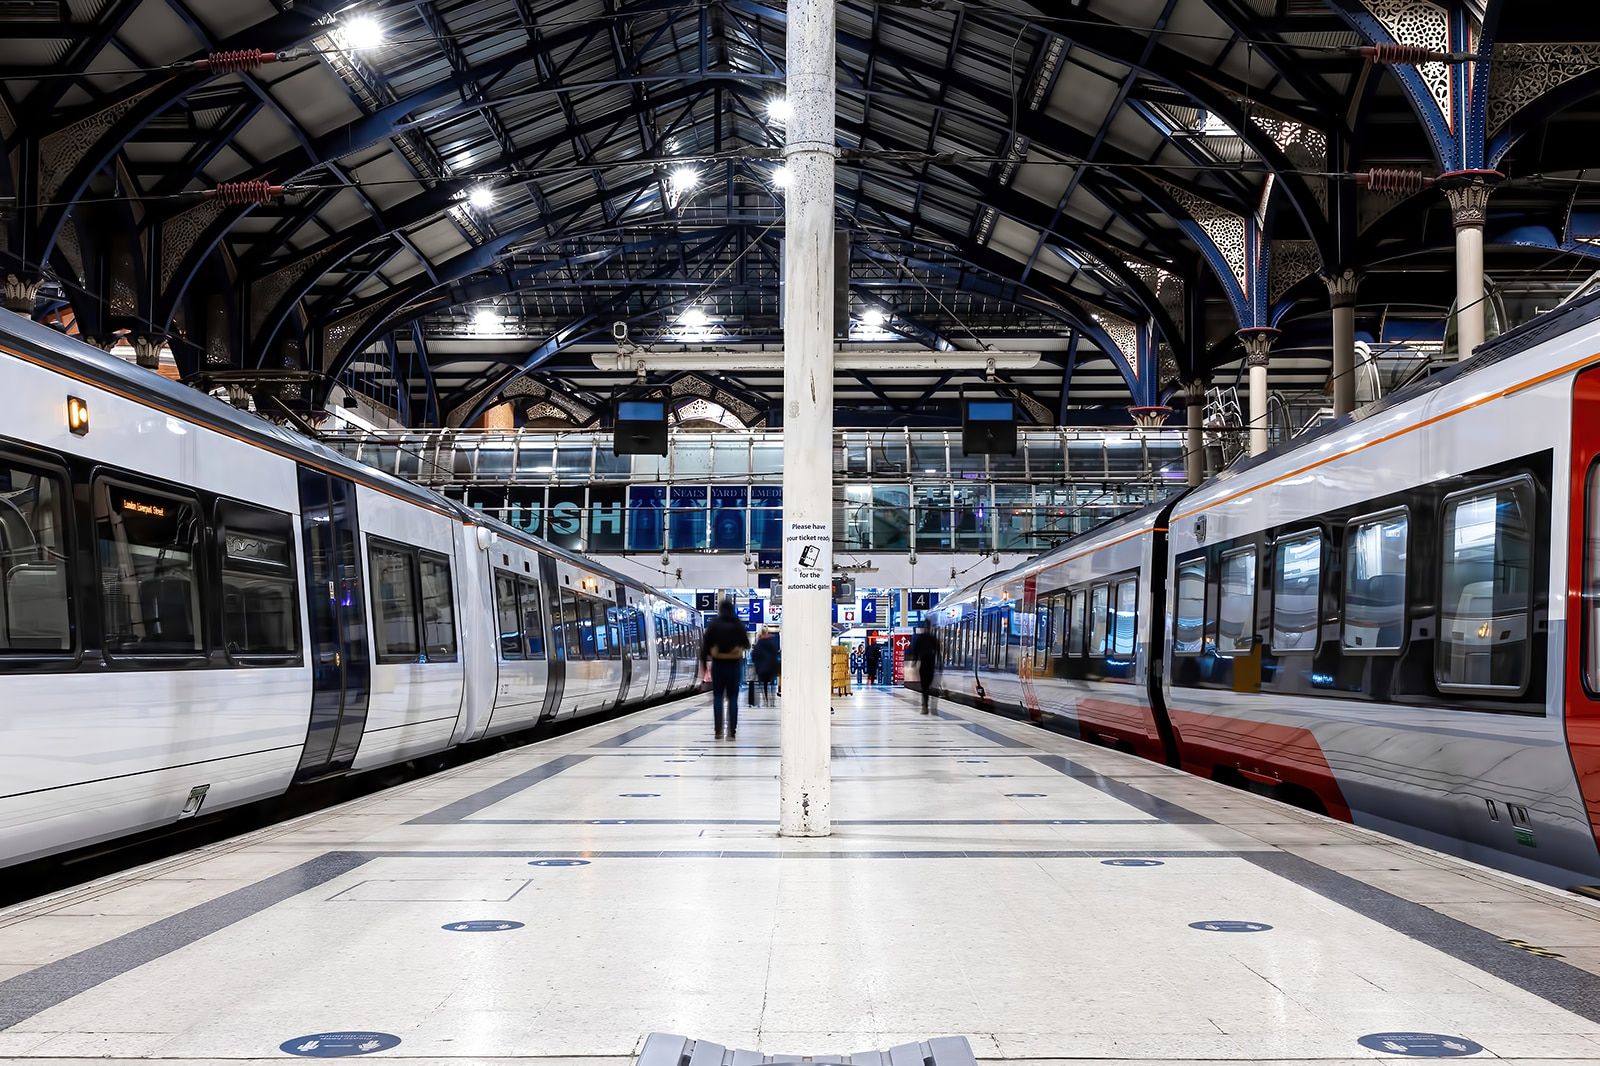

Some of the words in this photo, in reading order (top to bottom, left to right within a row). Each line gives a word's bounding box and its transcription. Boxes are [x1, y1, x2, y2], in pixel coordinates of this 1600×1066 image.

[712, 488, 738, 496] YARD
[702, 595, 710, 606] 5
[916, 595, 925, 606] 4
[753, 602, 760, 613] 5
[864, 602, 873, 612] 4
